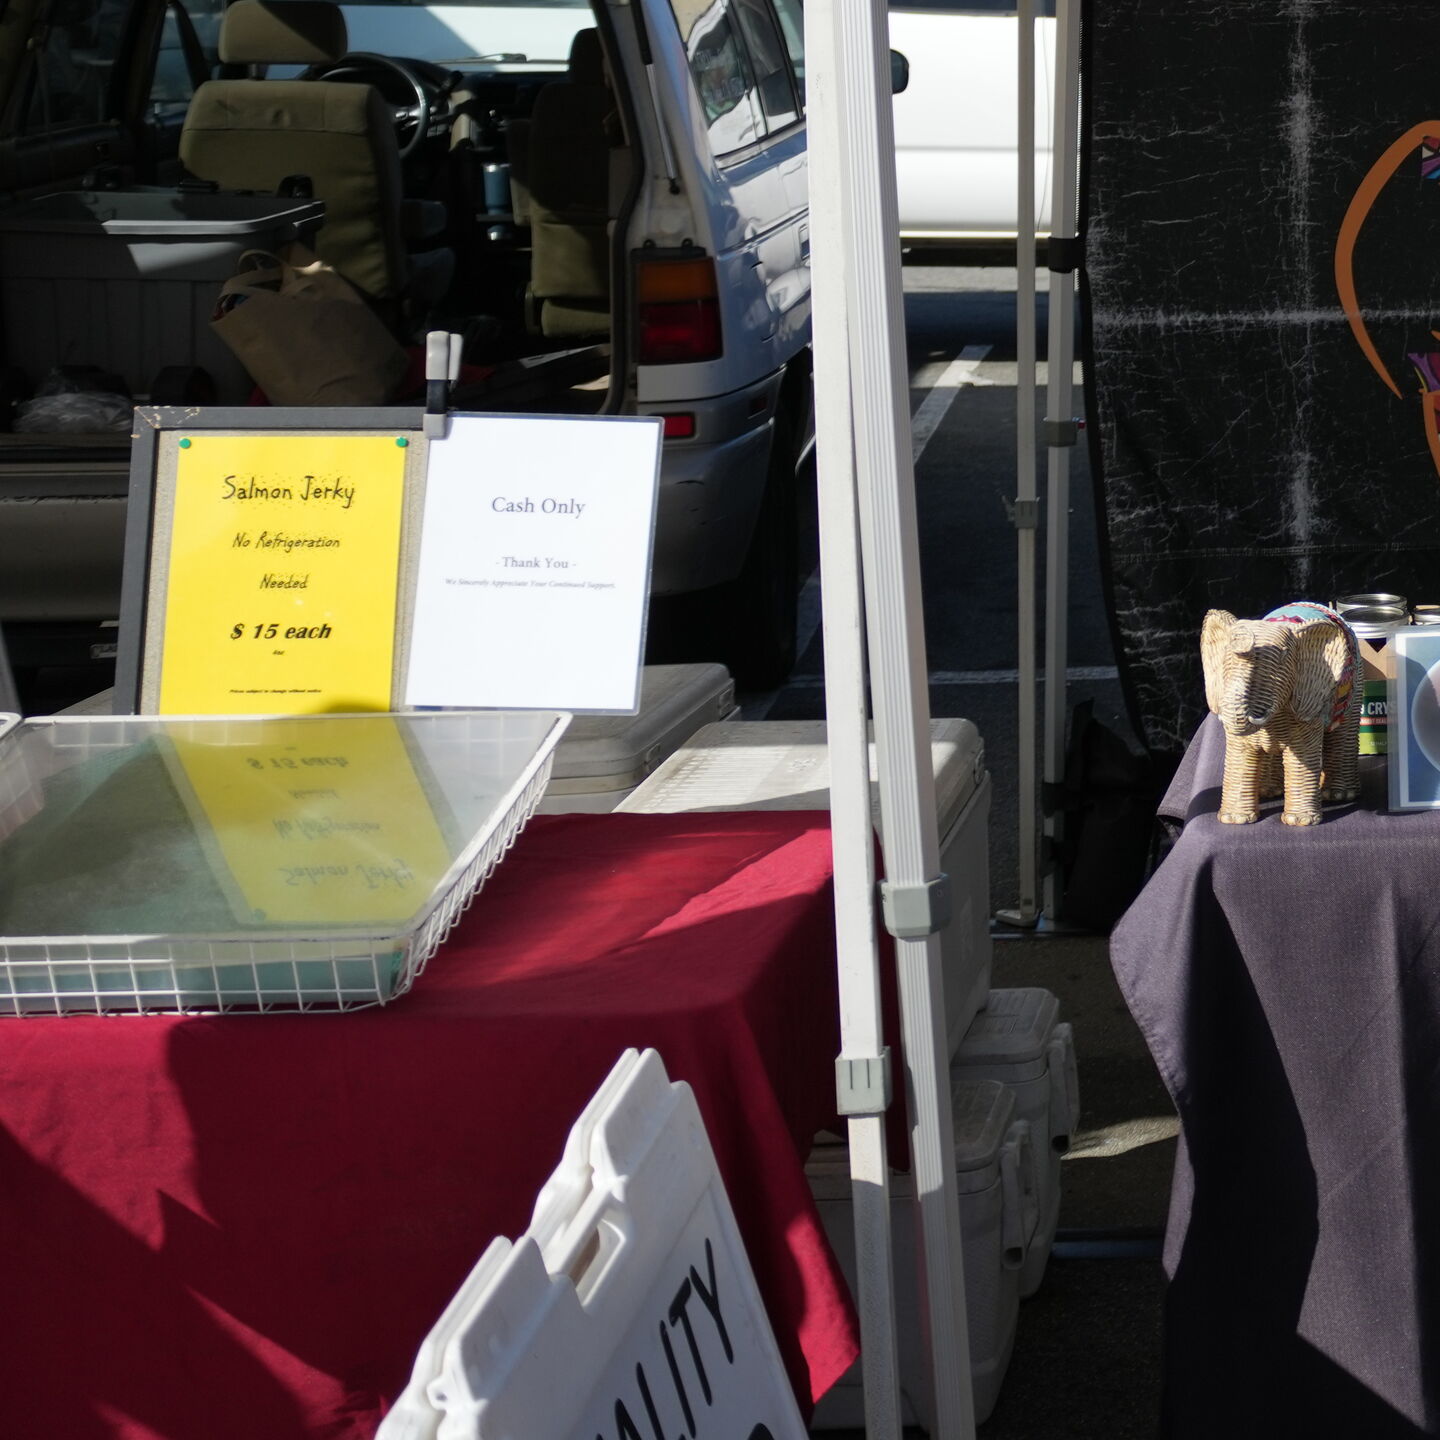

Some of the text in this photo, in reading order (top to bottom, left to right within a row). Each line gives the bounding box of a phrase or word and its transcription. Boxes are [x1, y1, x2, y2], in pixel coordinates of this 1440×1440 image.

[222, 475, 355, 509] Salmon Jerky
[491, 497, 586, 519] Cash Only
[232, 531, 340, 553] No Refrigeration
[502, 557, 569, 569] Thank You
[259, 573, 308, 589] Needed
[253, 623, 279, 639] 15
[284, 623, 332, 639] each
